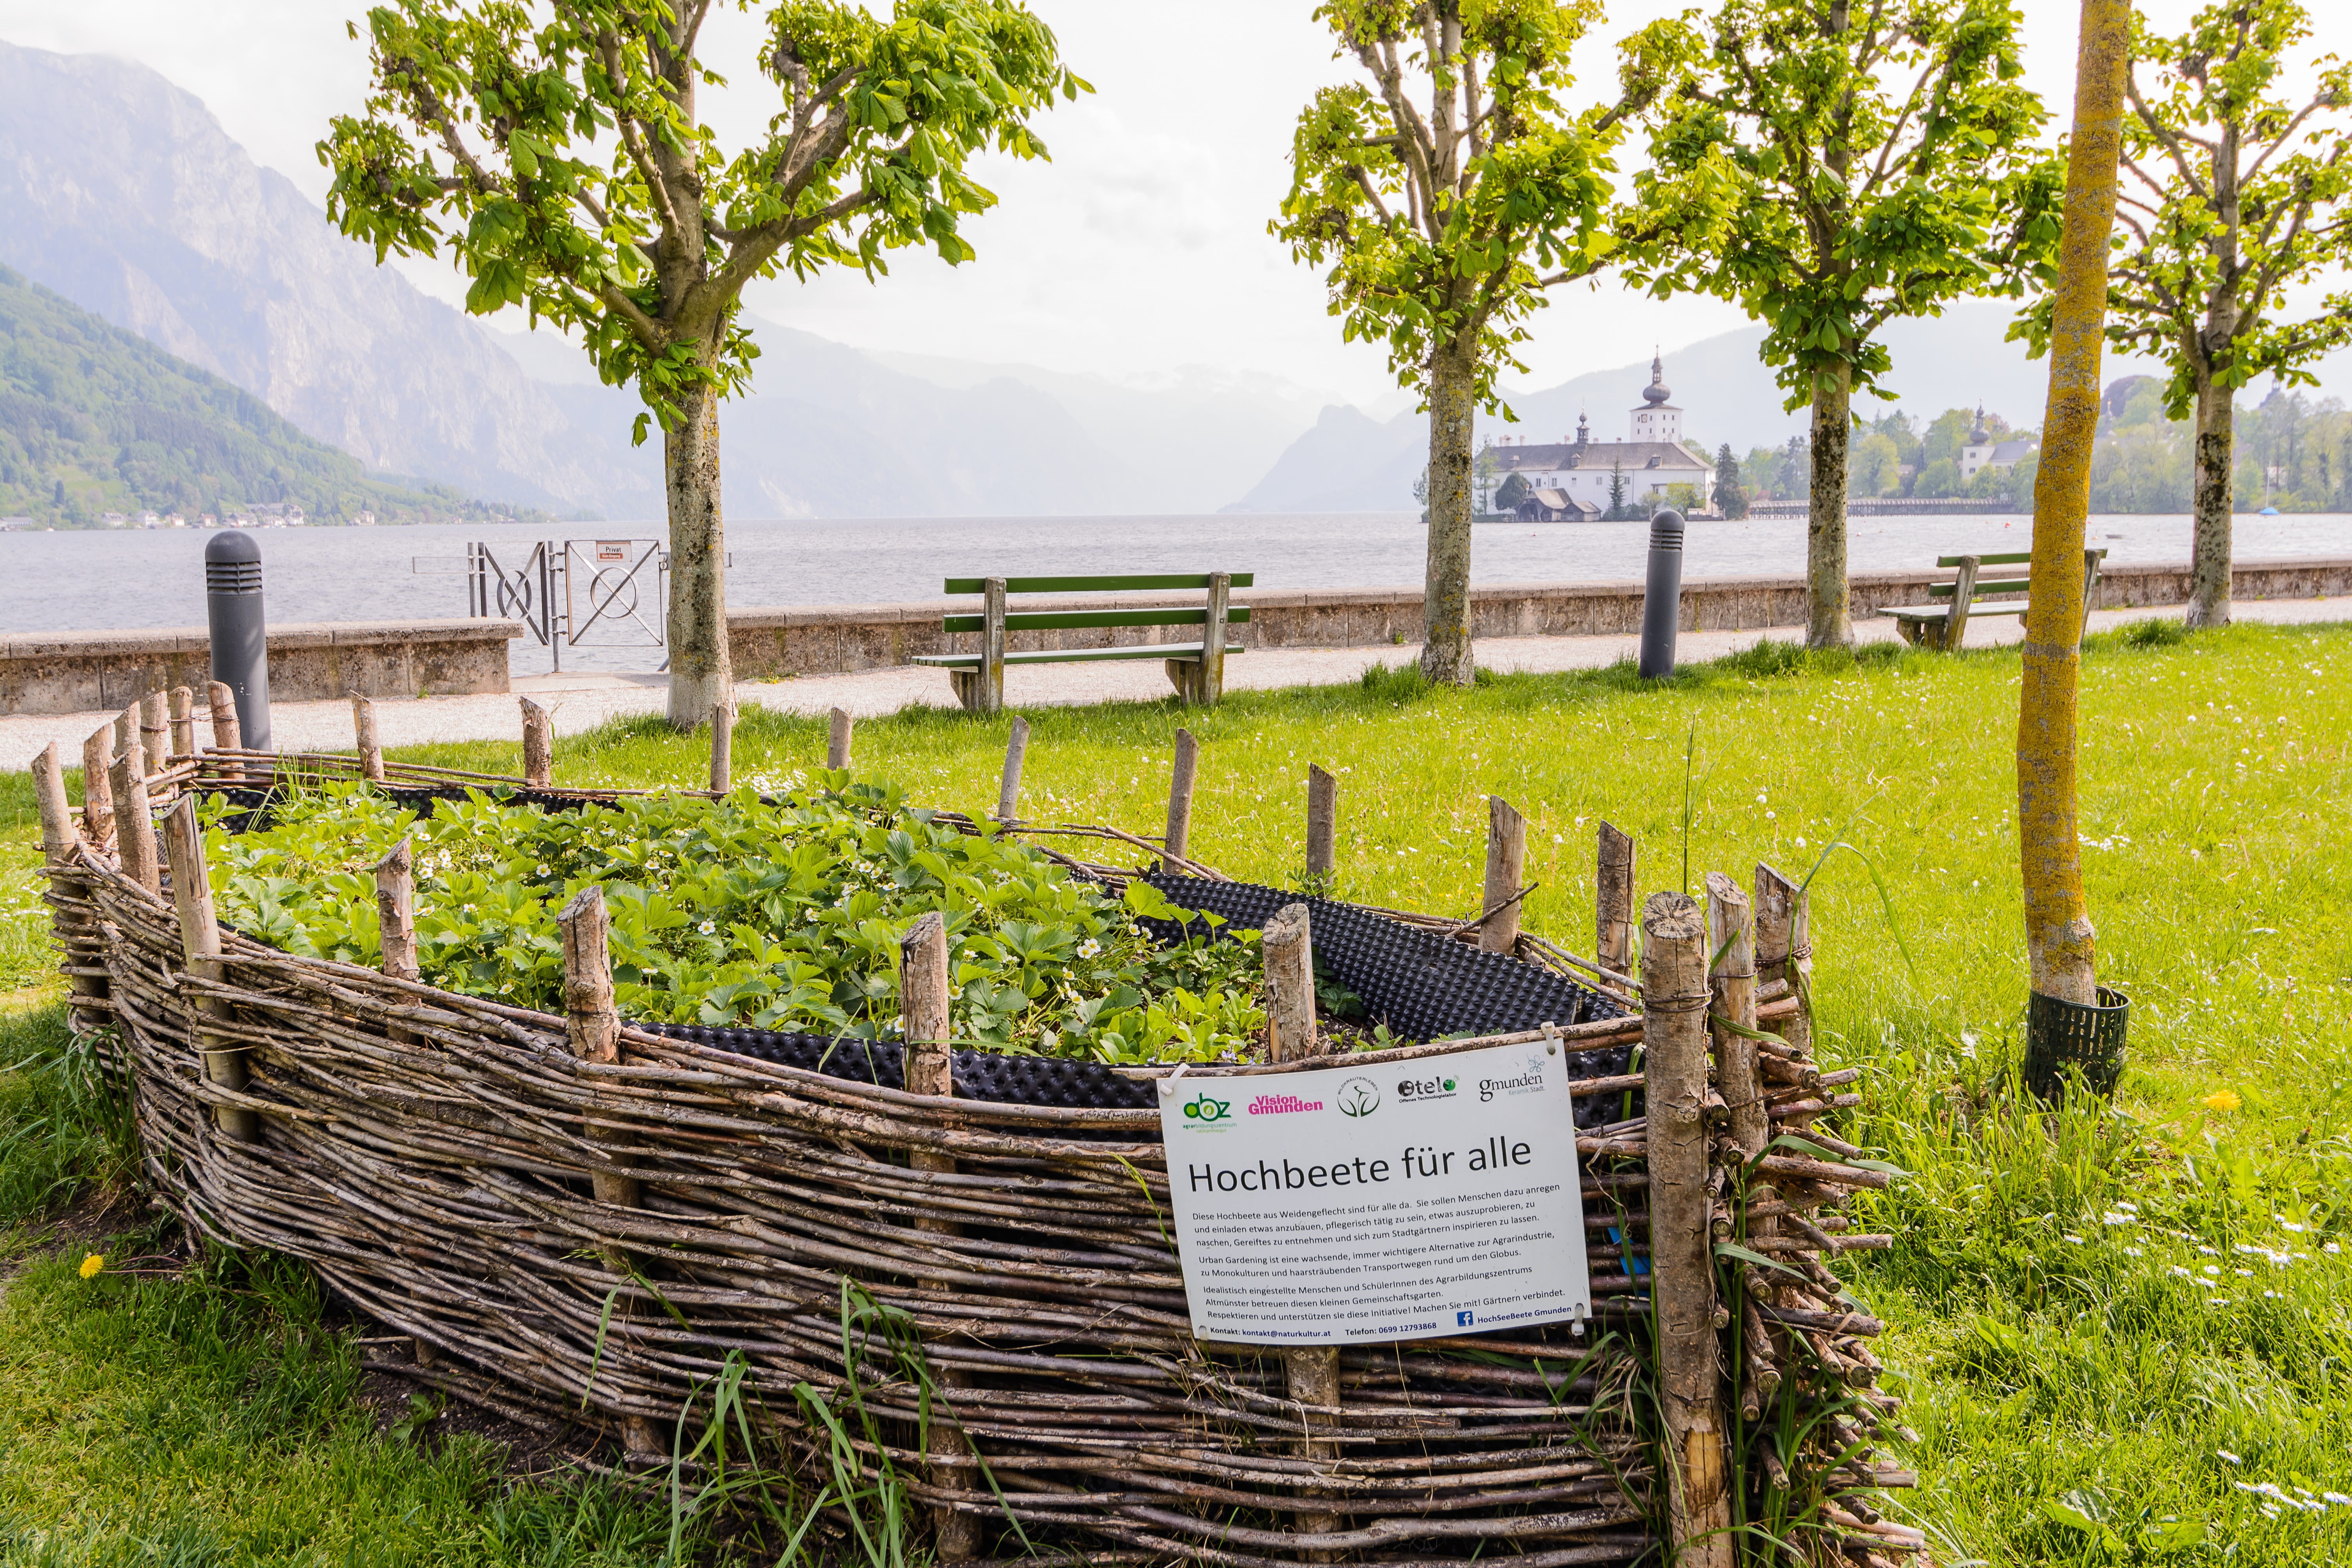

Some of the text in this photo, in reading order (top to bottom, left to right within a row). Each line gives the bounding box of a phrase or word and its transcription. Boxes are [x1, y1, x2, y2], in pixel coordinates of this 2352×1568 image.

[1338, 1076, 1379, 1095] WILDKRÄUTERLEBEN
[1417, 1093, 1457, 1101] Technologielabor
[1479, 1073, 1543, 1102] gmunden
[1183, 1092, 1232, 1122] abz
[1248, 1100, 1323, 1115] Gmunden
[1255, 1094, 1297, 1105] Vision
[1189, 1136, 1530, 1192] Hochbeete für alle
[1279, 1207, 1345, 1218] Weidengeflecht
[1348, 1205, 1365, 1214] sind
[1432, 1197, 1455, 1205] sollen
[1459, 1192, 1501, 1202] Menschen
[1526, 1185, 1559, 1194] anregen
[1326, 1219, 1371, 1230] pflegerisch
[1374, 1217, 1393, 1225] tätig
[1456, 1204, 1523, 1216] auszuprobieren,
[1285, 1236, 1332, 1245] entnehmen
[1392, 1226, 1450, 1237] Stadtgärtnern
[1453, 1221, 1497, 1231] inspirieren
[1226, 1256, 1267, 1265] Gardening
[1301, 1253, 1350, 1262] wachsende,
[1383, 1247, 1426, 1256] wichtigere
[1429, 1241, 1474, 1252] Alternative
[1493, 1231, 1554, 1245] Agrarindustrie,
[1290, 1266, 1361, 1276] haarsträubenden
[1363, 1261, 1431, 1272] Transportwegen
[1434, 1256, 1453, 1265] rund
[1490, 1250, 1521, 1258] Globus.
[1250, 1285, 1296, 1296] eingestellte
[1362, 1281, 1416, 1290] SchülerInnen
[1436, 1267, 1532, 1284] Agrarbildungszentrums
[1208, 1311, 1258, 1320] Respektieren
[1372, 1307, 1410, 1317] Initiative!
[1414, 1304, 1446, 1313] Machen
[1464, 1299, 1480, 1308] mit!
[1483, 1296, 1520, 1305] Gärtnern
[1523, 1289, 1565, 1300] verbindet.
[1352, 1292, 1443, 1304] Gemeinschaftsgarten.
[1400, 1323, 1436, 1332] 12793868
[1478, 1312, 1532, 1323] HochSeeBeete
[1535, 1307, 1571, 1316] Gmunden
[1242, 1329, 1330, 1338] kontakt@naturkultur.at
